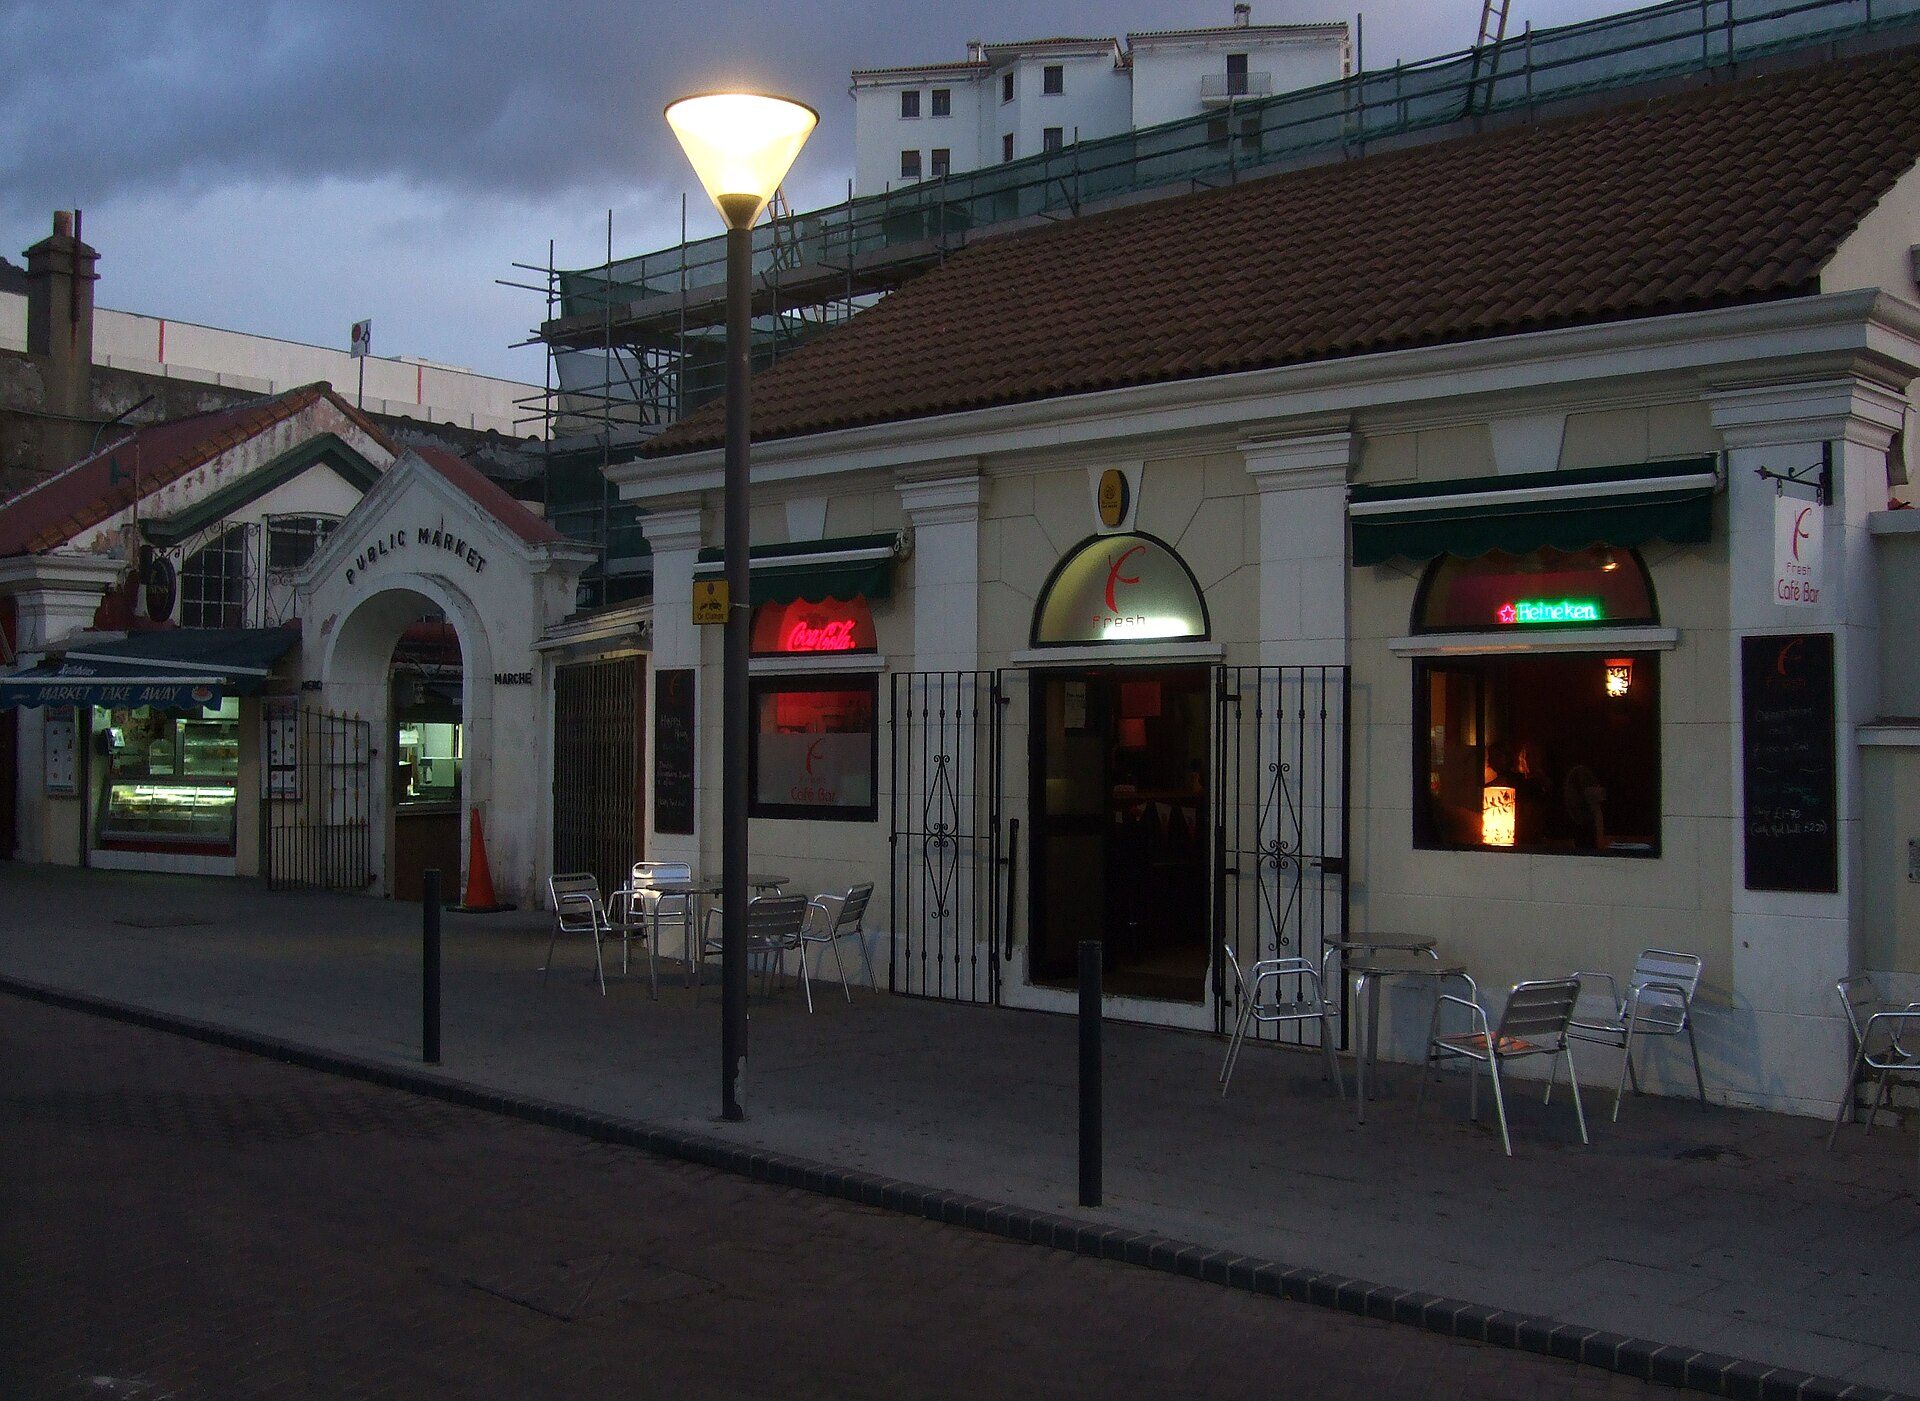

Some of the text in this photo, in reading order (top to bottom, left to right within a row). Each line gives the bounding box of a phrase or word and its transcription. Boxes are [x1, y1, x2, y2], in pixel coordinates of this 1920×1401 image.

[346, 527, 487, 585] PUBLIC MARKET
[1778, 579, 1820, 603] Café Bar
[1517, 600, 1598, 622] Heineken
[38, 685, 182, 702] MARKET TAKE AWAY
